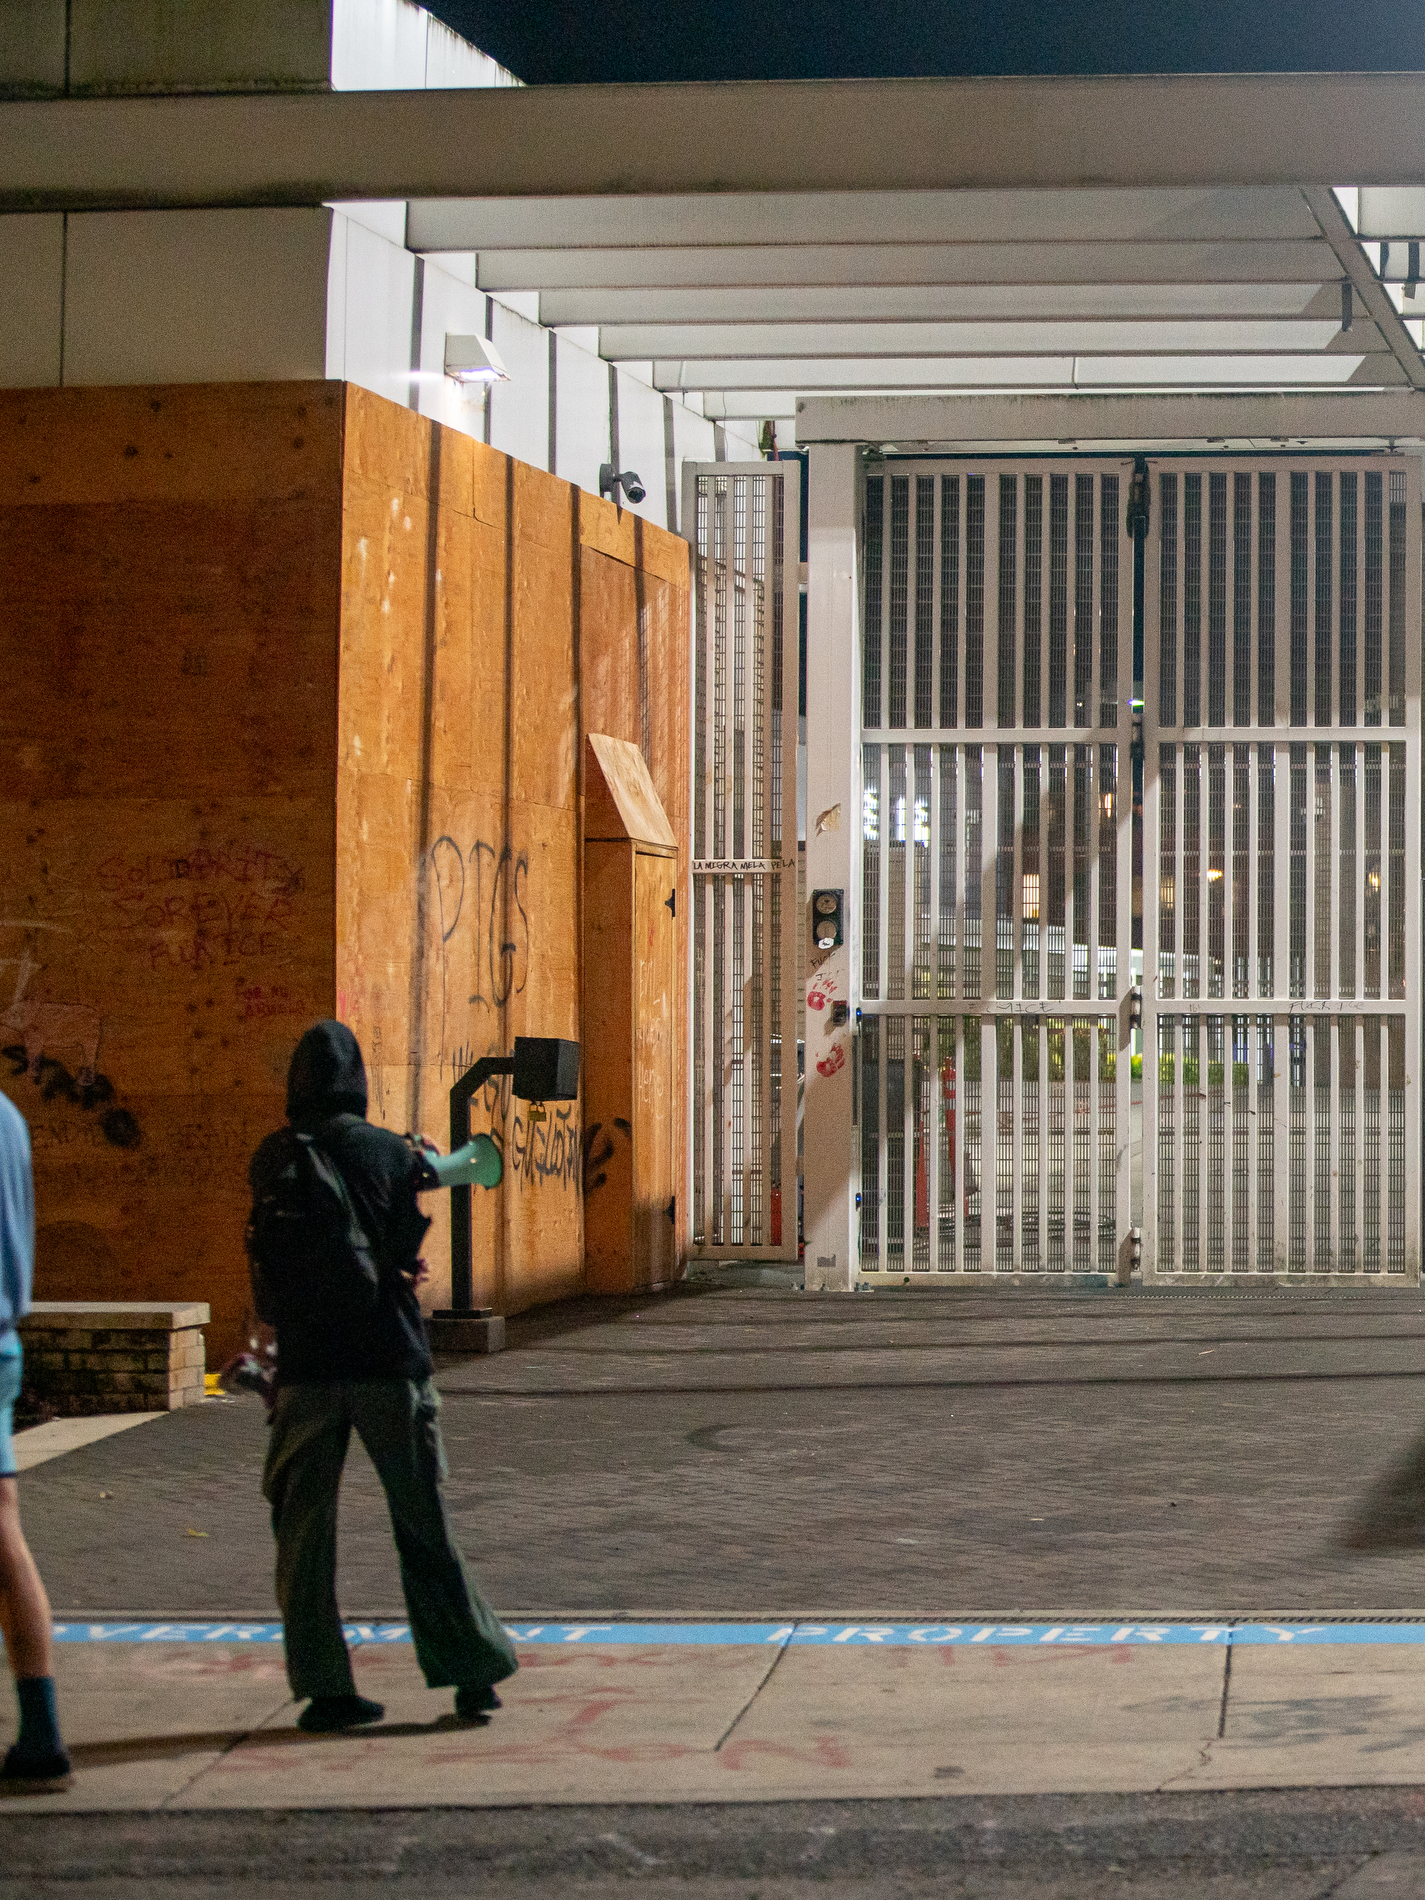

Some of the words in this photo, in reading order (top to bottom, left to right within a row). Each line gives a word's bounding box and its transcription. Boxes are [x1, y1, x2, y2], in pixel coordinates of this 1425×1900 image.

[693, 861, 703, 870] LA
[704, 861, 738, 871] MIGRA
[429, 835, 530, 1010] PIGS
[766, 1625, 1326, 1642] PROPERTY
